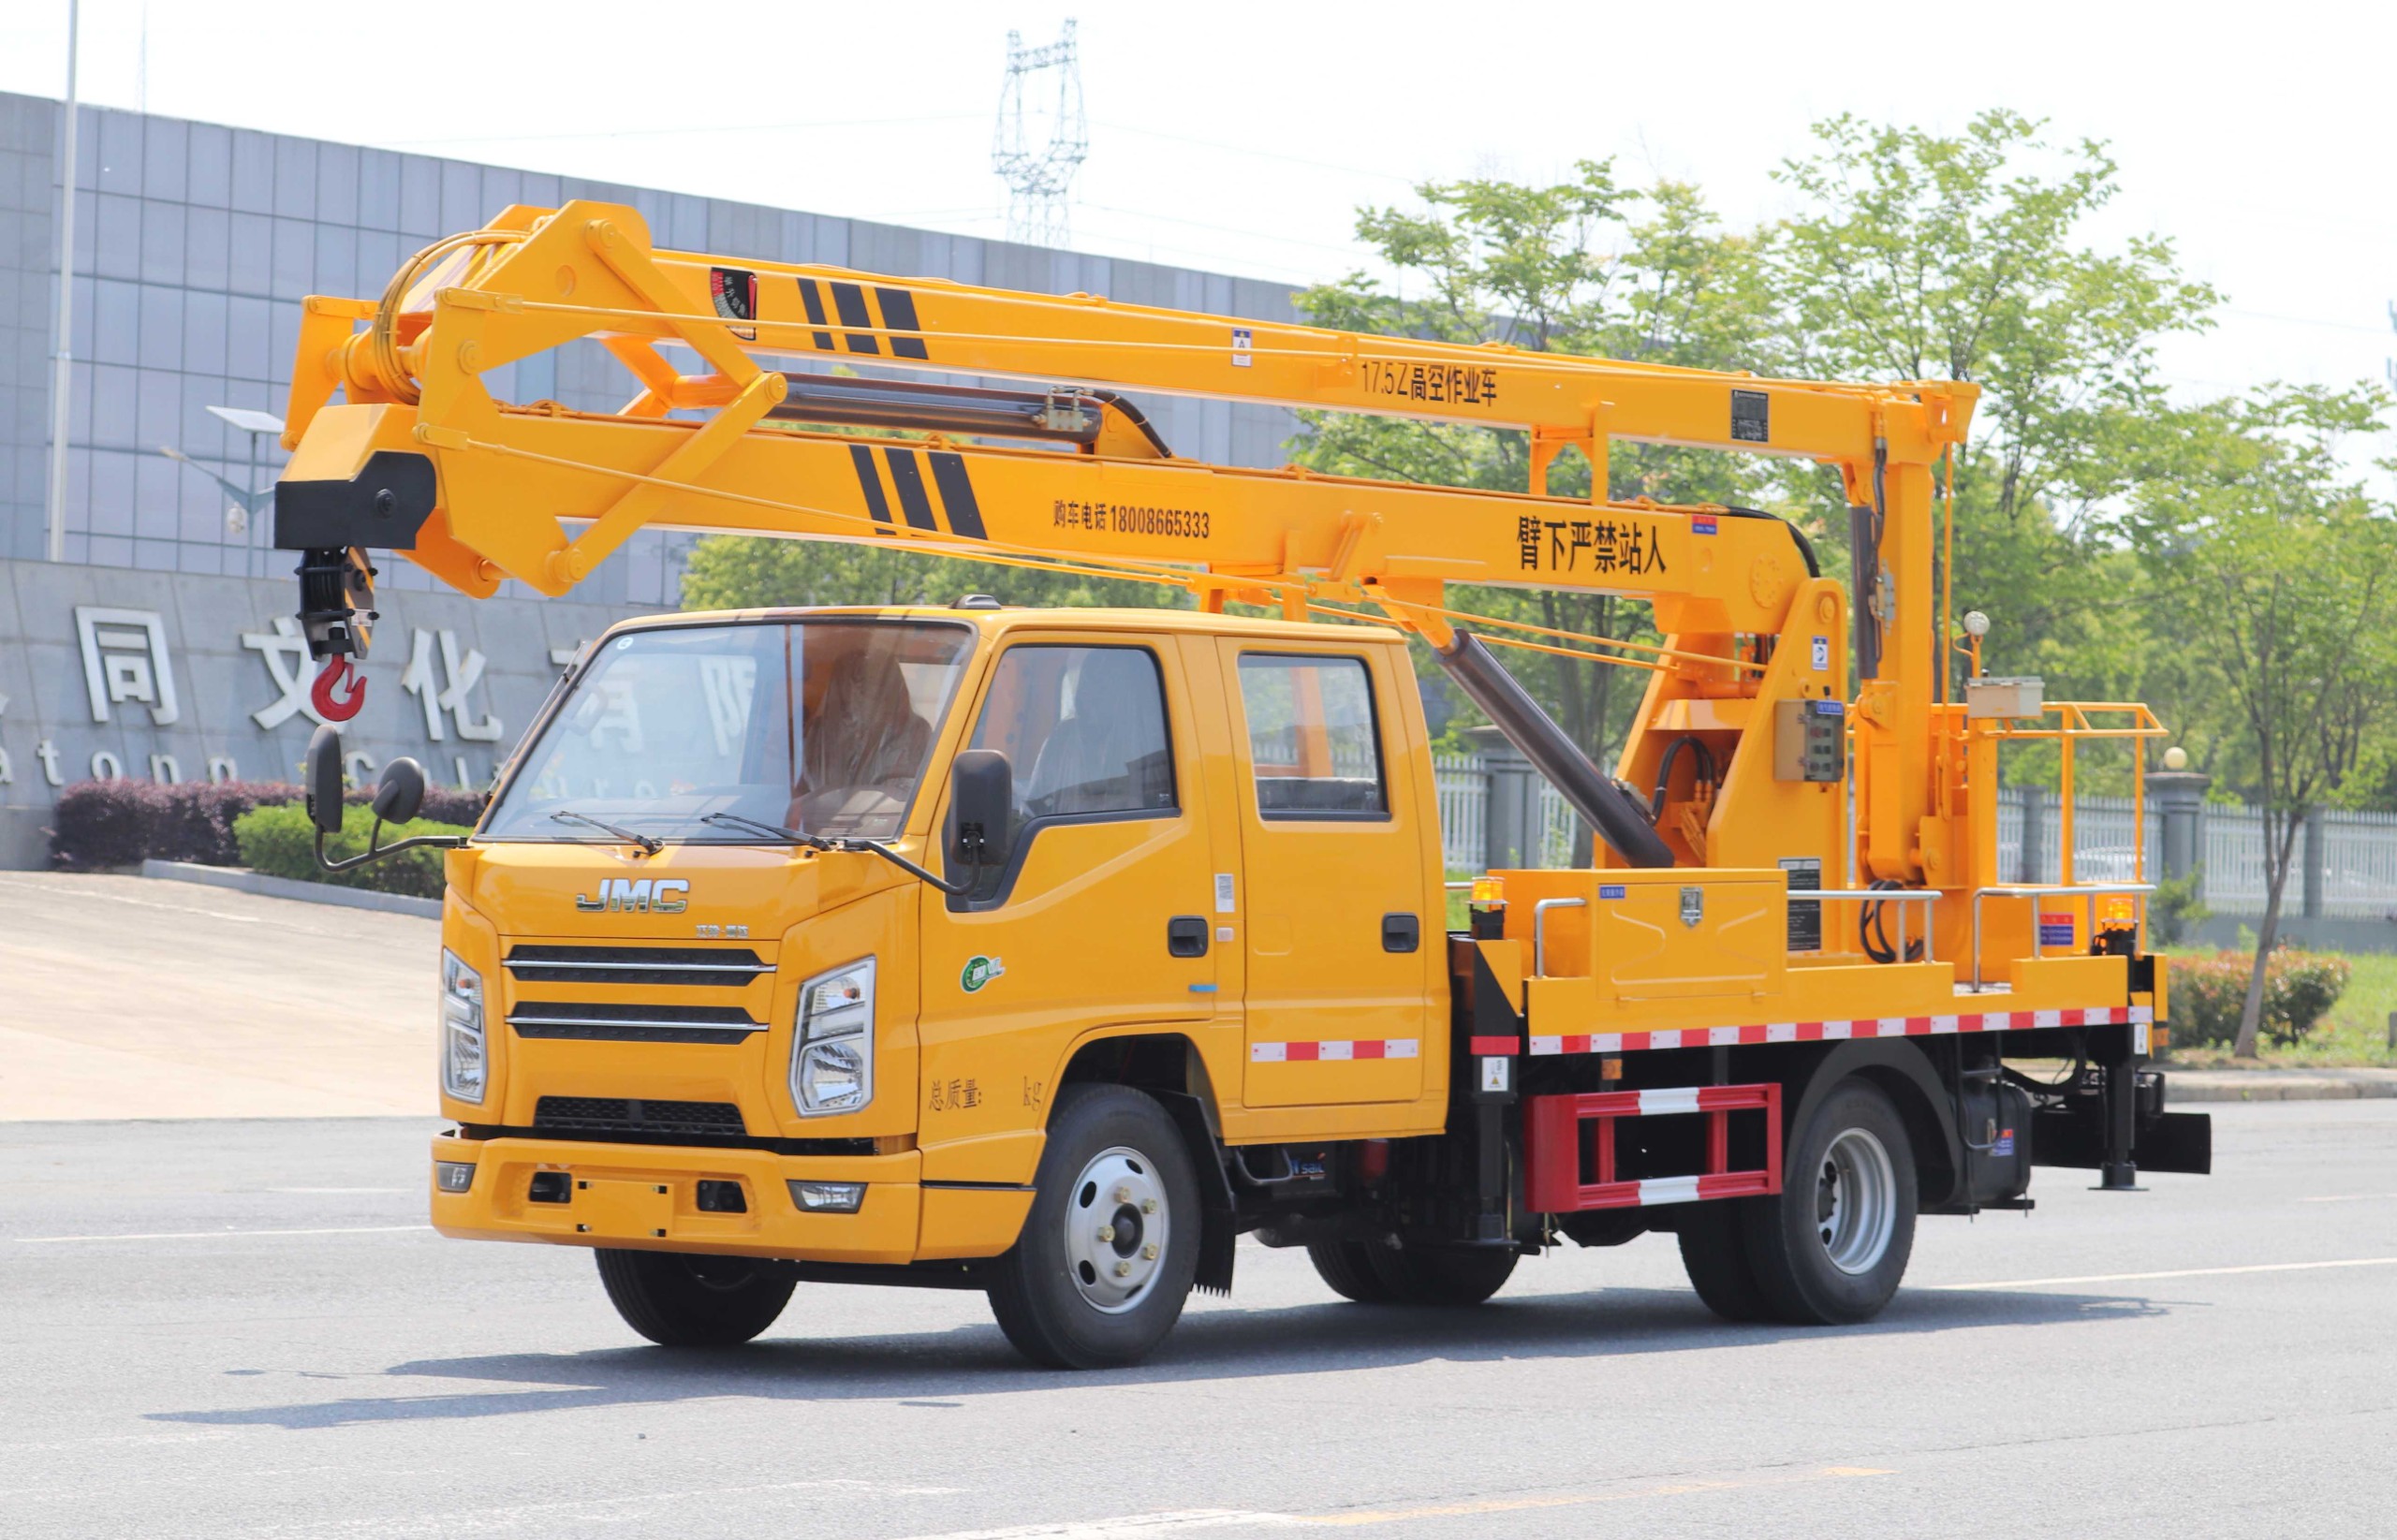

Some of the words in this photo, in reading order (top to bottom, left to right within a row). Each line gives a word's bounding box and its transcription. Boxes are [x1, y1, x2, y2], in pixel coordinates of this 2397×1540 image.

[1517, 516, 1667, 575] 臂下严禁站人
[575, 877, 690, 915] JMC
[1023, 1075, 1042, 1112] kg
